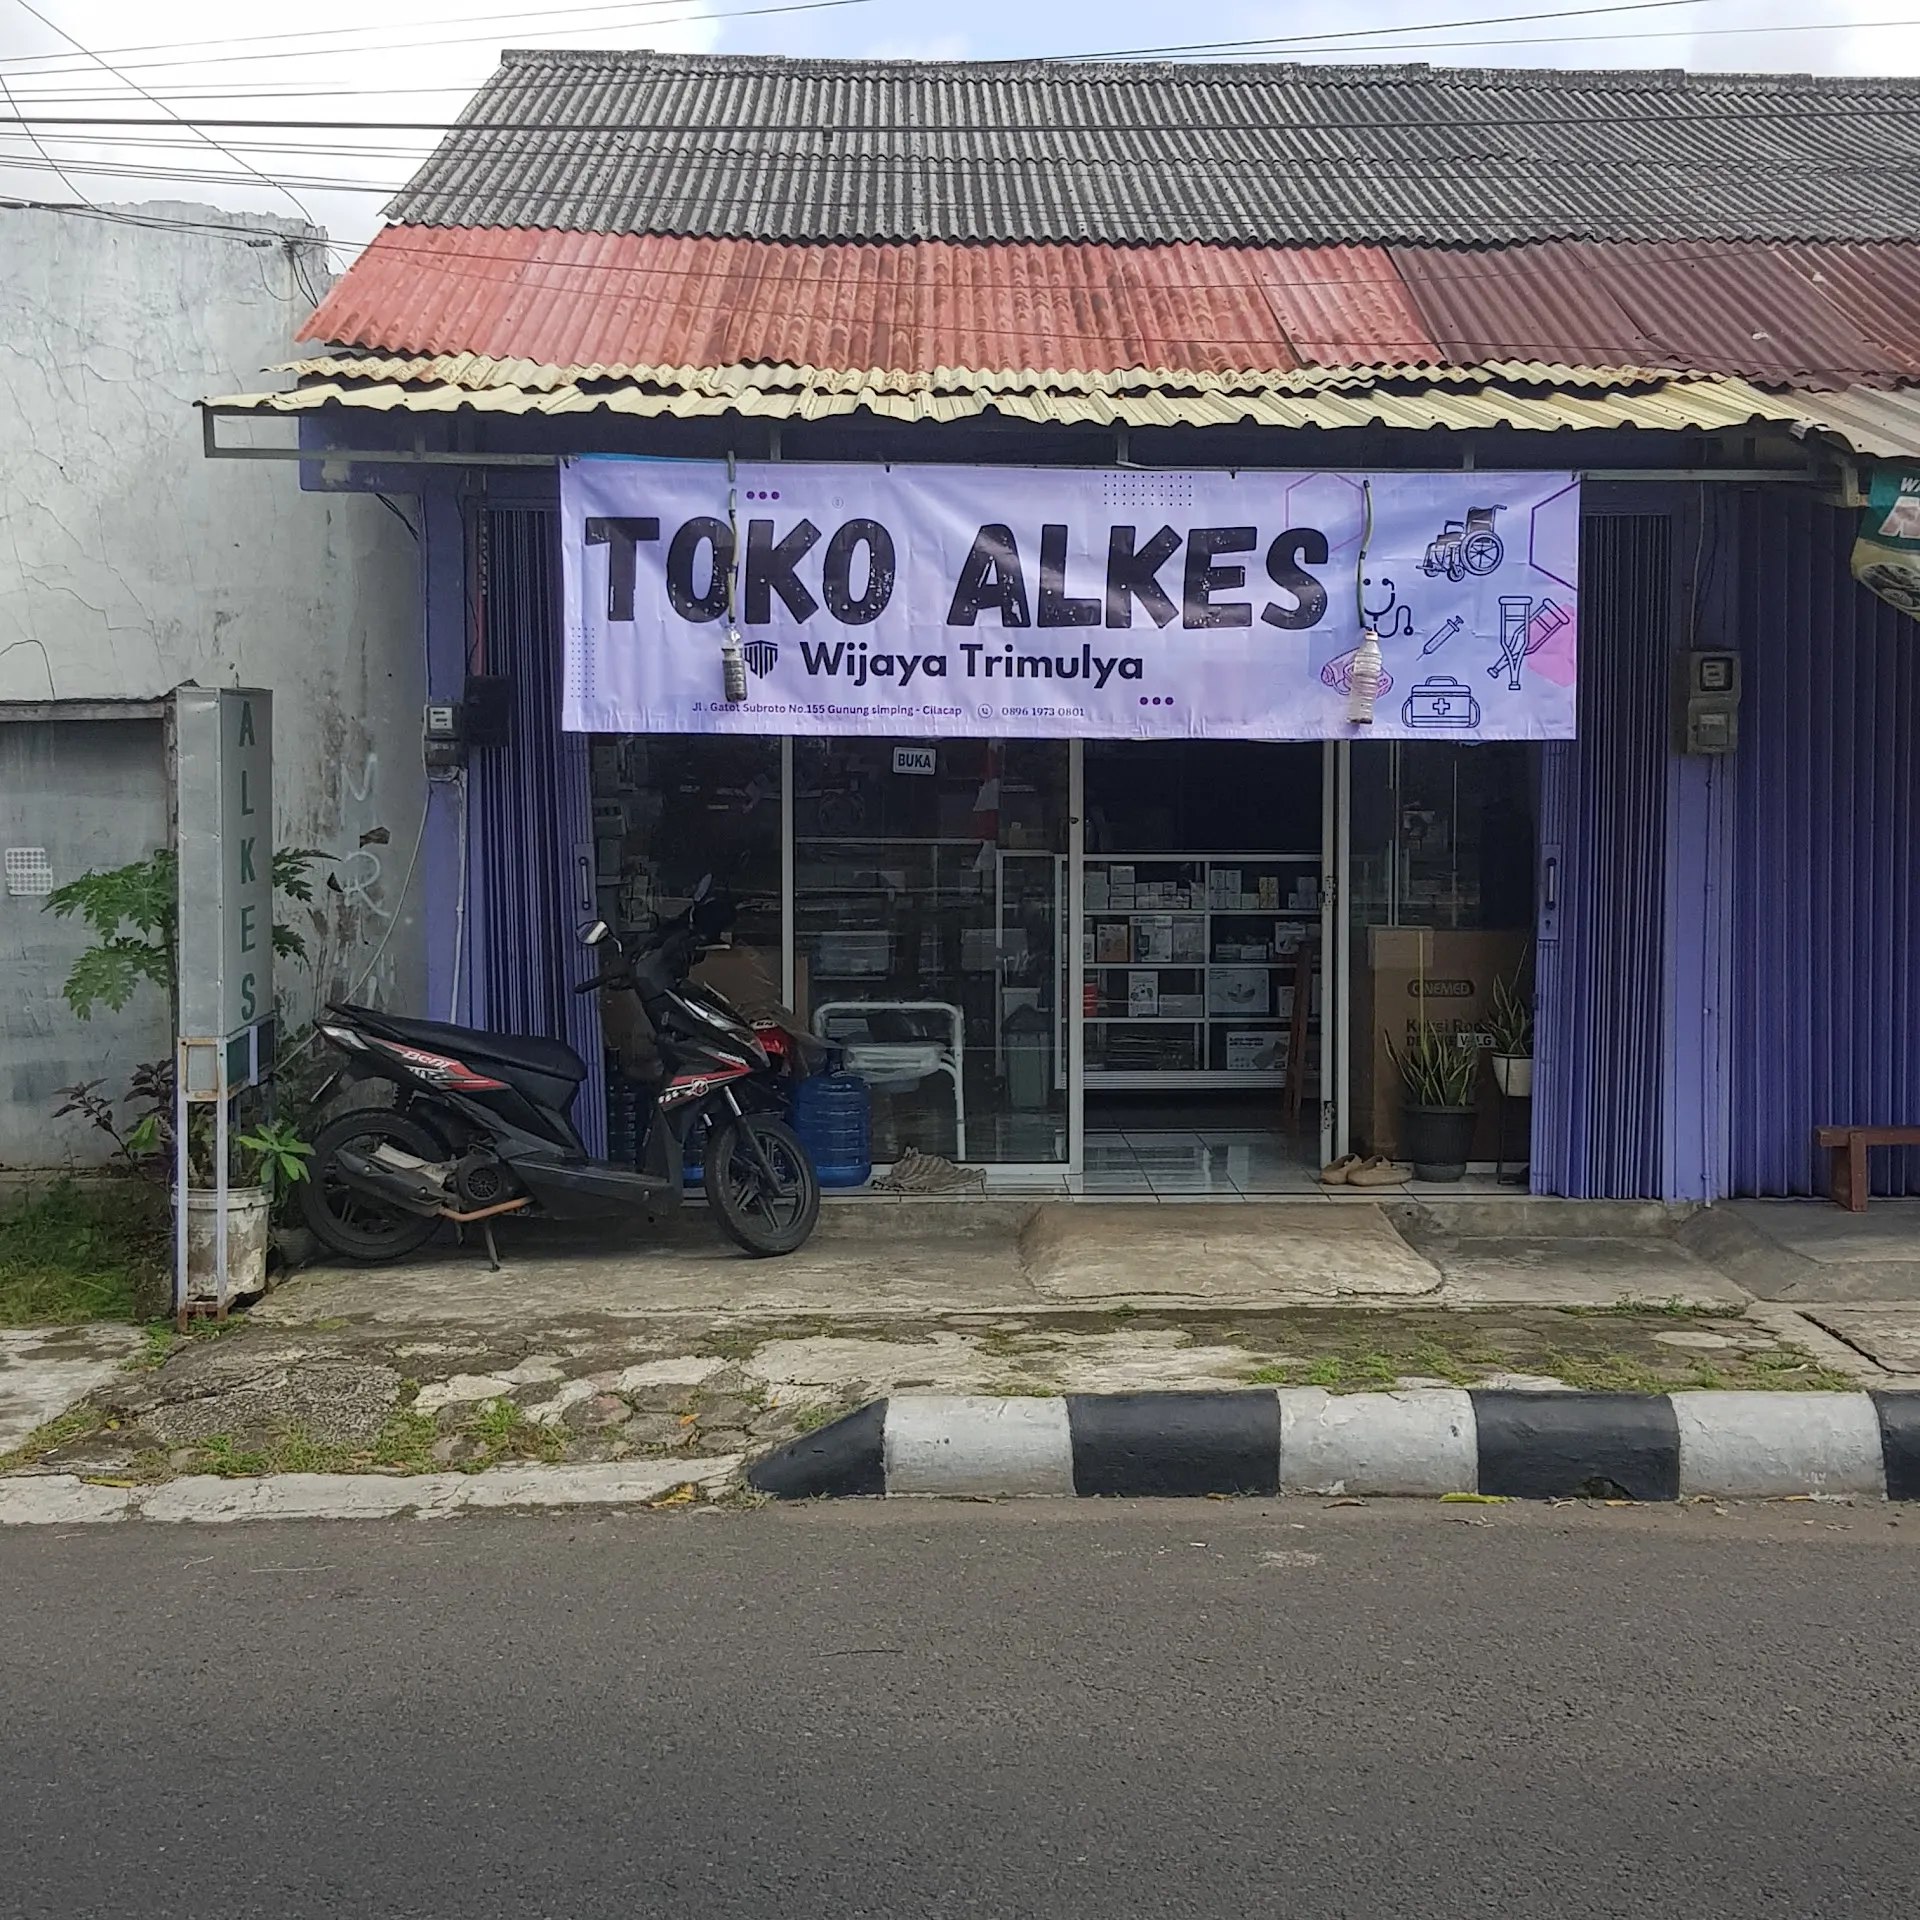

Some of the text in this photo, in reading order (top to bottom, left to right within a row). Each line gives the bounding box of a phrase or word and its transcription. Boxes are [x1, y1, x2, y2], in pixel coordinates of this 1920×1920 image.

[585, 516, 1330, 630] TOKO ALKES
[799, 641, 1143, 689] Wijaya Trimulya
[710, 703, 740, 713] Gatot
[743, 704, 786, 714] Subroto
[788, 704, 824, 714] No.155
[827, 705, 869, 717] Gunung
[922, 705, 962, 718] Cilacap
[1001, 707, 1084, 716] 0896 1973 0801
[897, 753, 931, 768] BUKA
[238, 700, 256, 1021] ALKES
